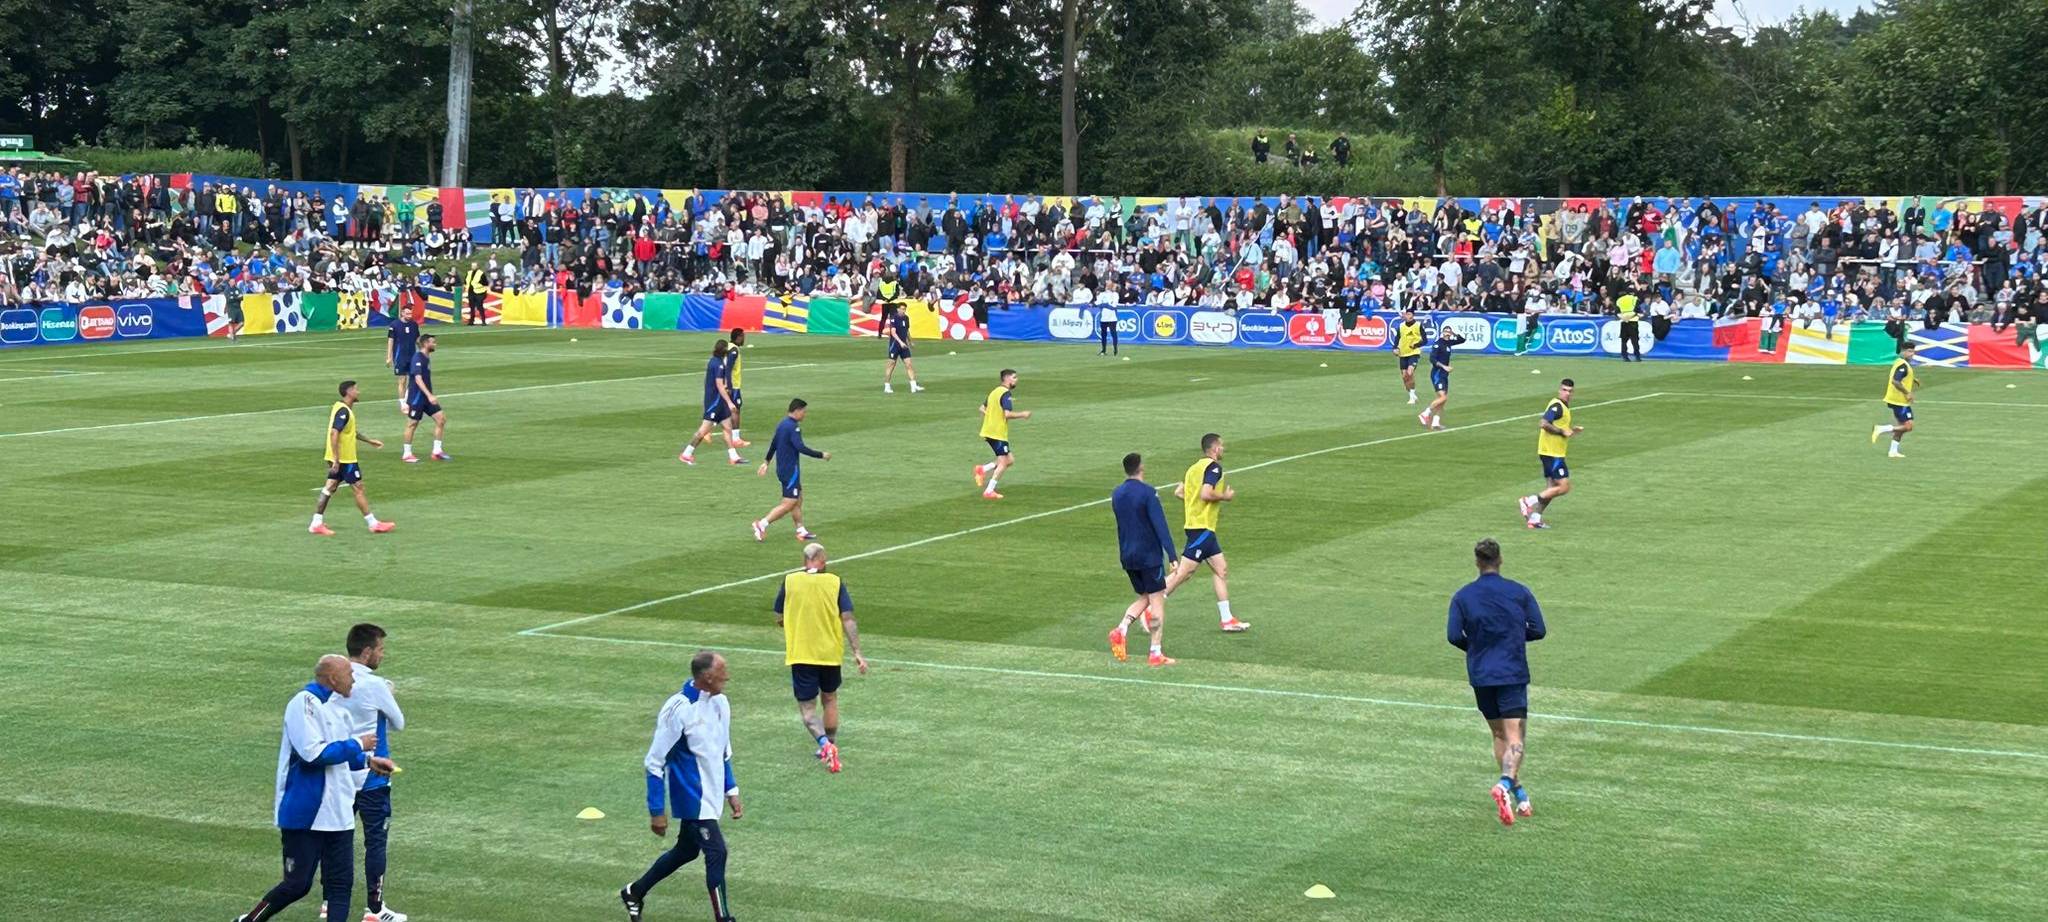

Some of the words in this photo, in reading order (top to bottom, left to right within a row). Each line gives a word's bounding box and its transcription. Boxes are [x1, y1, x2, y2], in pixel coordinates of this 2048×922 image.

[42, 320, 75, 329] Hisense
[118, 312, 151, 327] vivo
[1193, 321, 1235, 332] BYD
[1241, 324, 1285, 333] Booking.com
